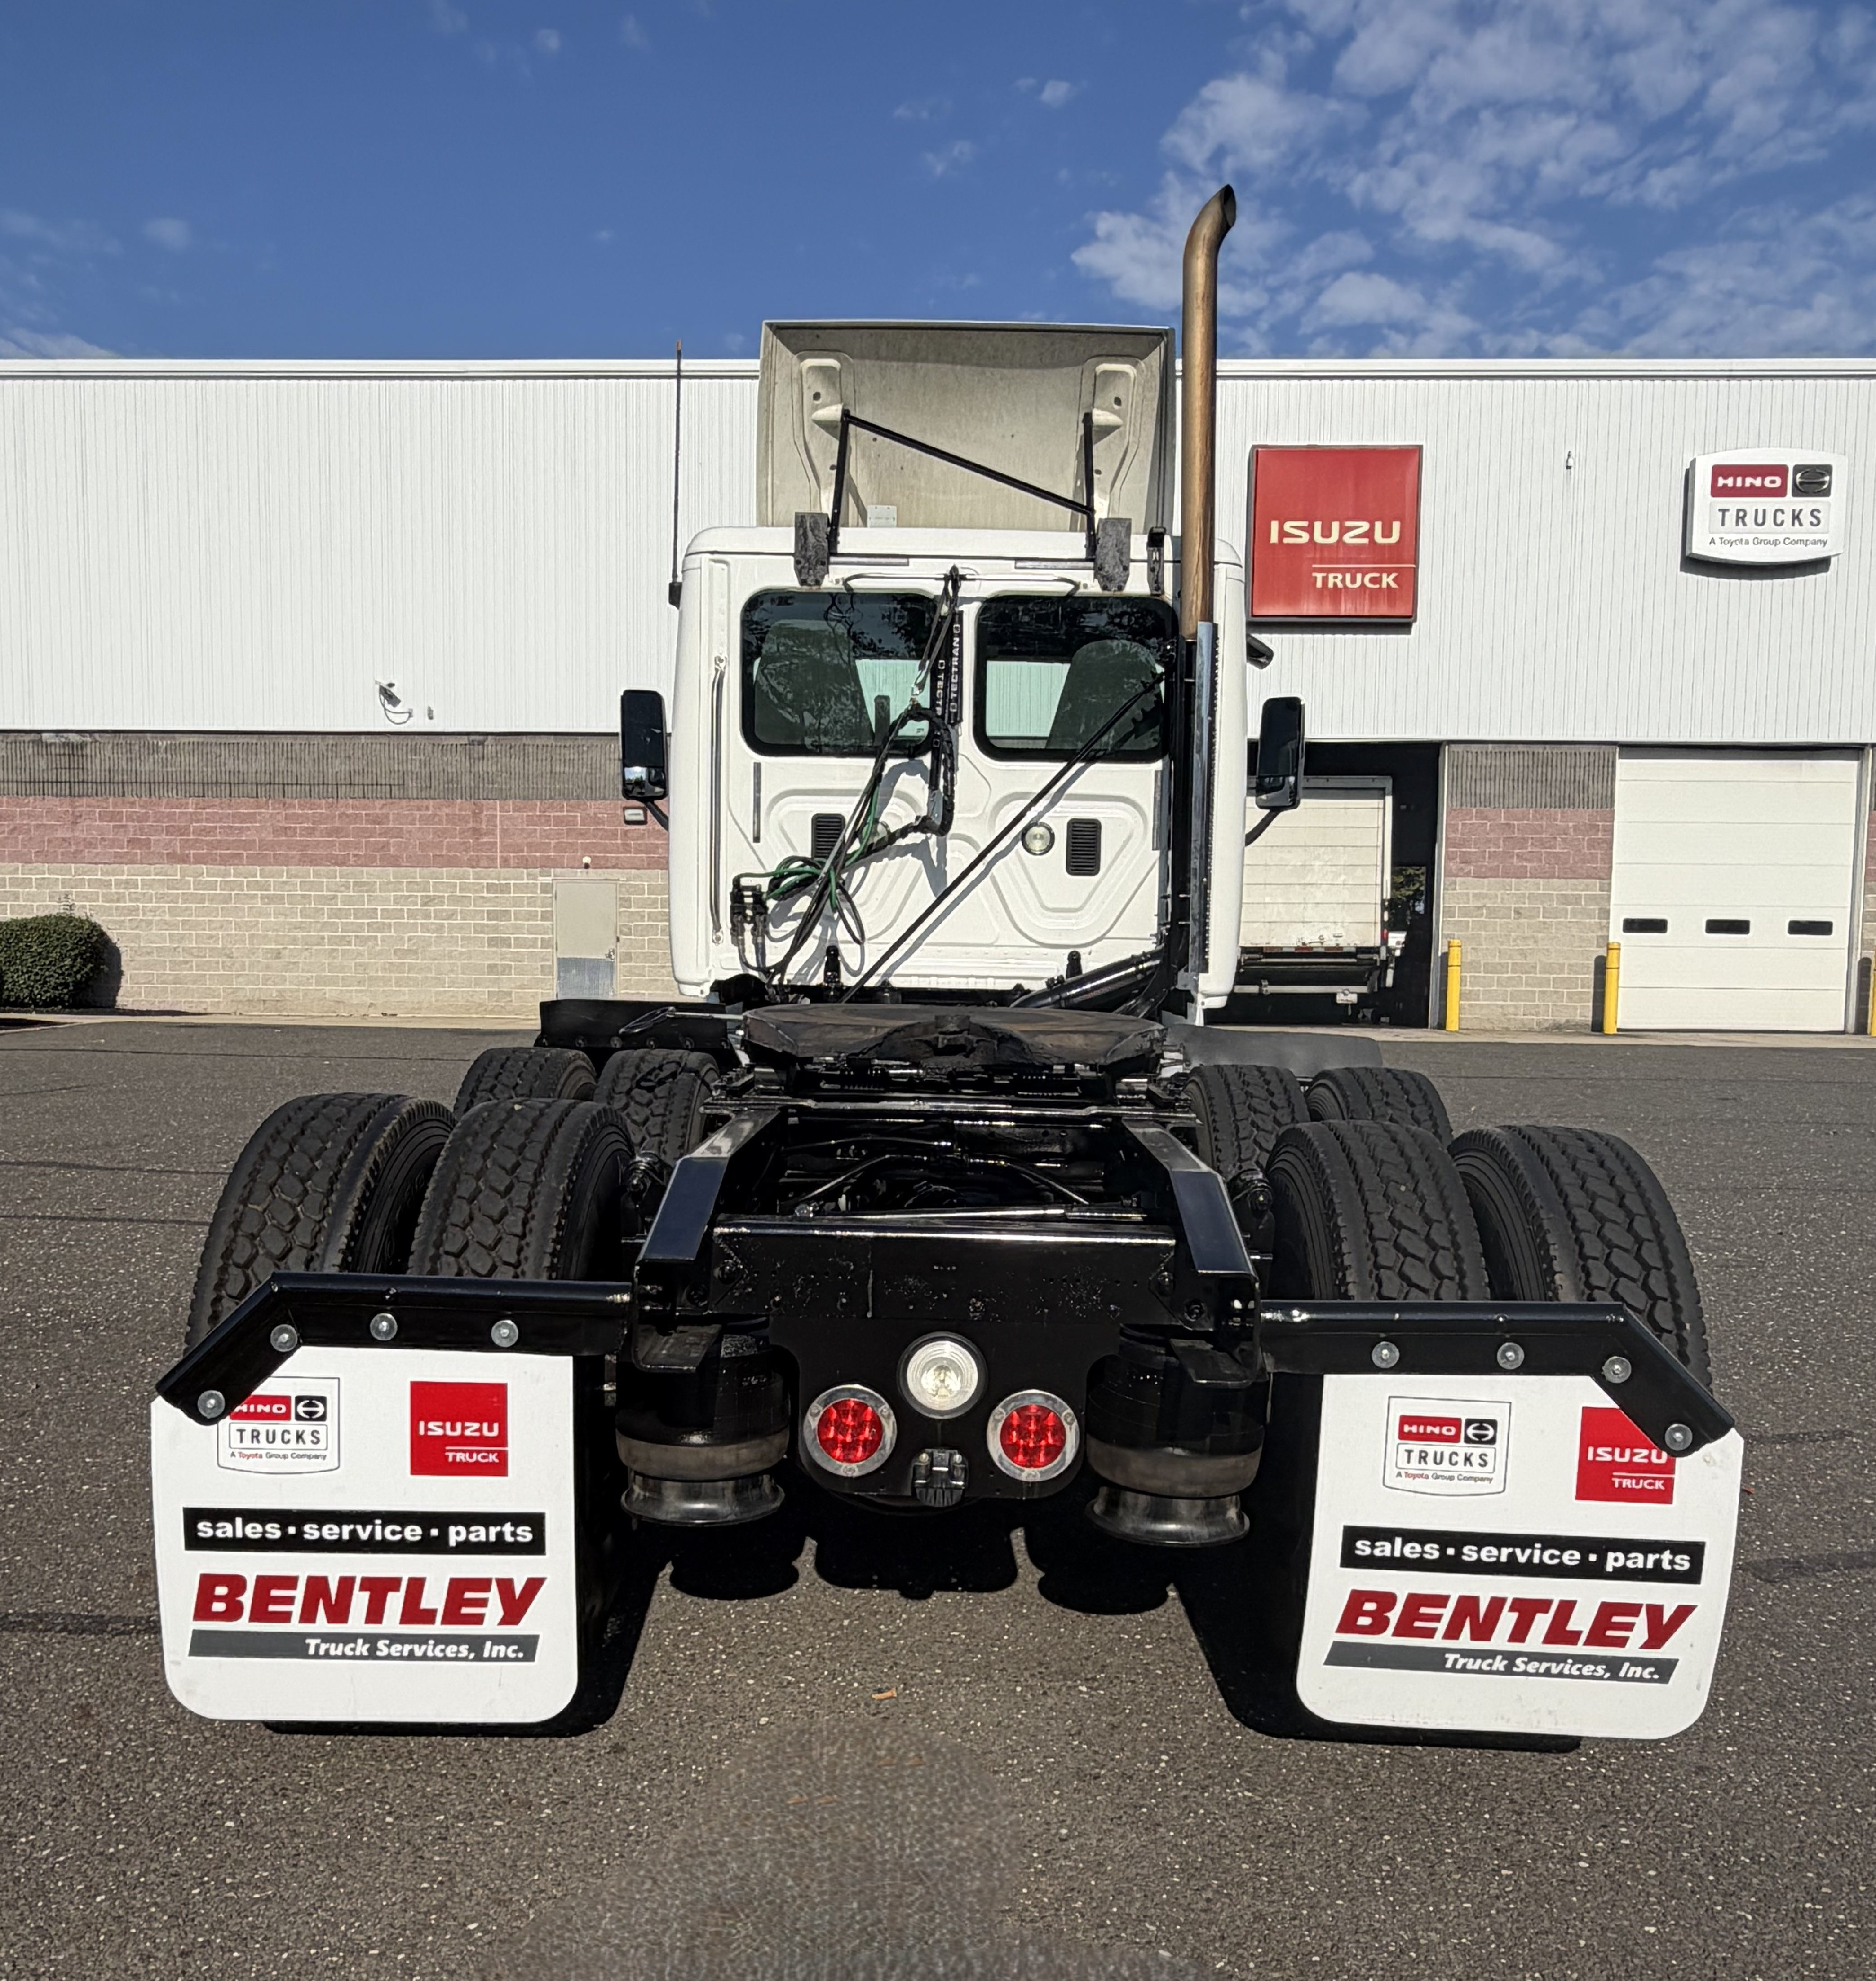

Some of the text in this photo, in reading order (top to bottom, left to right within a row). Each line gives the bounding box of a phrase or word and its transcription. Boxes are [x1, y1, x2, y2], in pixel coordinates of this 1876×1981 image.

[1717, 476, 1782, 488] HINO
[1717, 508, 1822, 527] TRUCKS
[1270, 520, 1400, 544] ISUZU
[1719, 537, 1750, 547] Toyota
[1752, 537, 1781, 547] Group
[1783, 537, 1828, 548] Company
[1312, 572, 1398, 588] TRUCK
[236, 1429, 320, 1445] TRUCKS
[419, 1421, 499, 1437] ISUZU
[1403, 1424, 1456, 1435] HINO
[238, 1451, 263, 1460] Toyota
[265, 1452, 288, 1460] Group
[291, 1452, 327, 1461] Company
[445, 1452, 500, 1463] TRUCK
[1404, 1449, 1488, 1468] TRUCKS
[1587, 1446, 1668, 1464] ISUZU
[1404, 1472, 1429, 1480] Toyota
[1431, 1472, 1455, 1481] Group
[1457, 1474, 1494, 1484] Company
[1611, 1477, 1665, 1490] TRUCK
[197, 1517, 533, 1547] sales service parts
[1354, 1537, 1691, 1572] sales service parts
[192, 1573, 547, 1626] BENTLEY
[1335, 1589, 1698, 1650] BENTLEY
[305, 1638, 524, 1660] Truck Services, Inc.
[1443, 1653, 1660, 1680] Truck Services, Inc.
